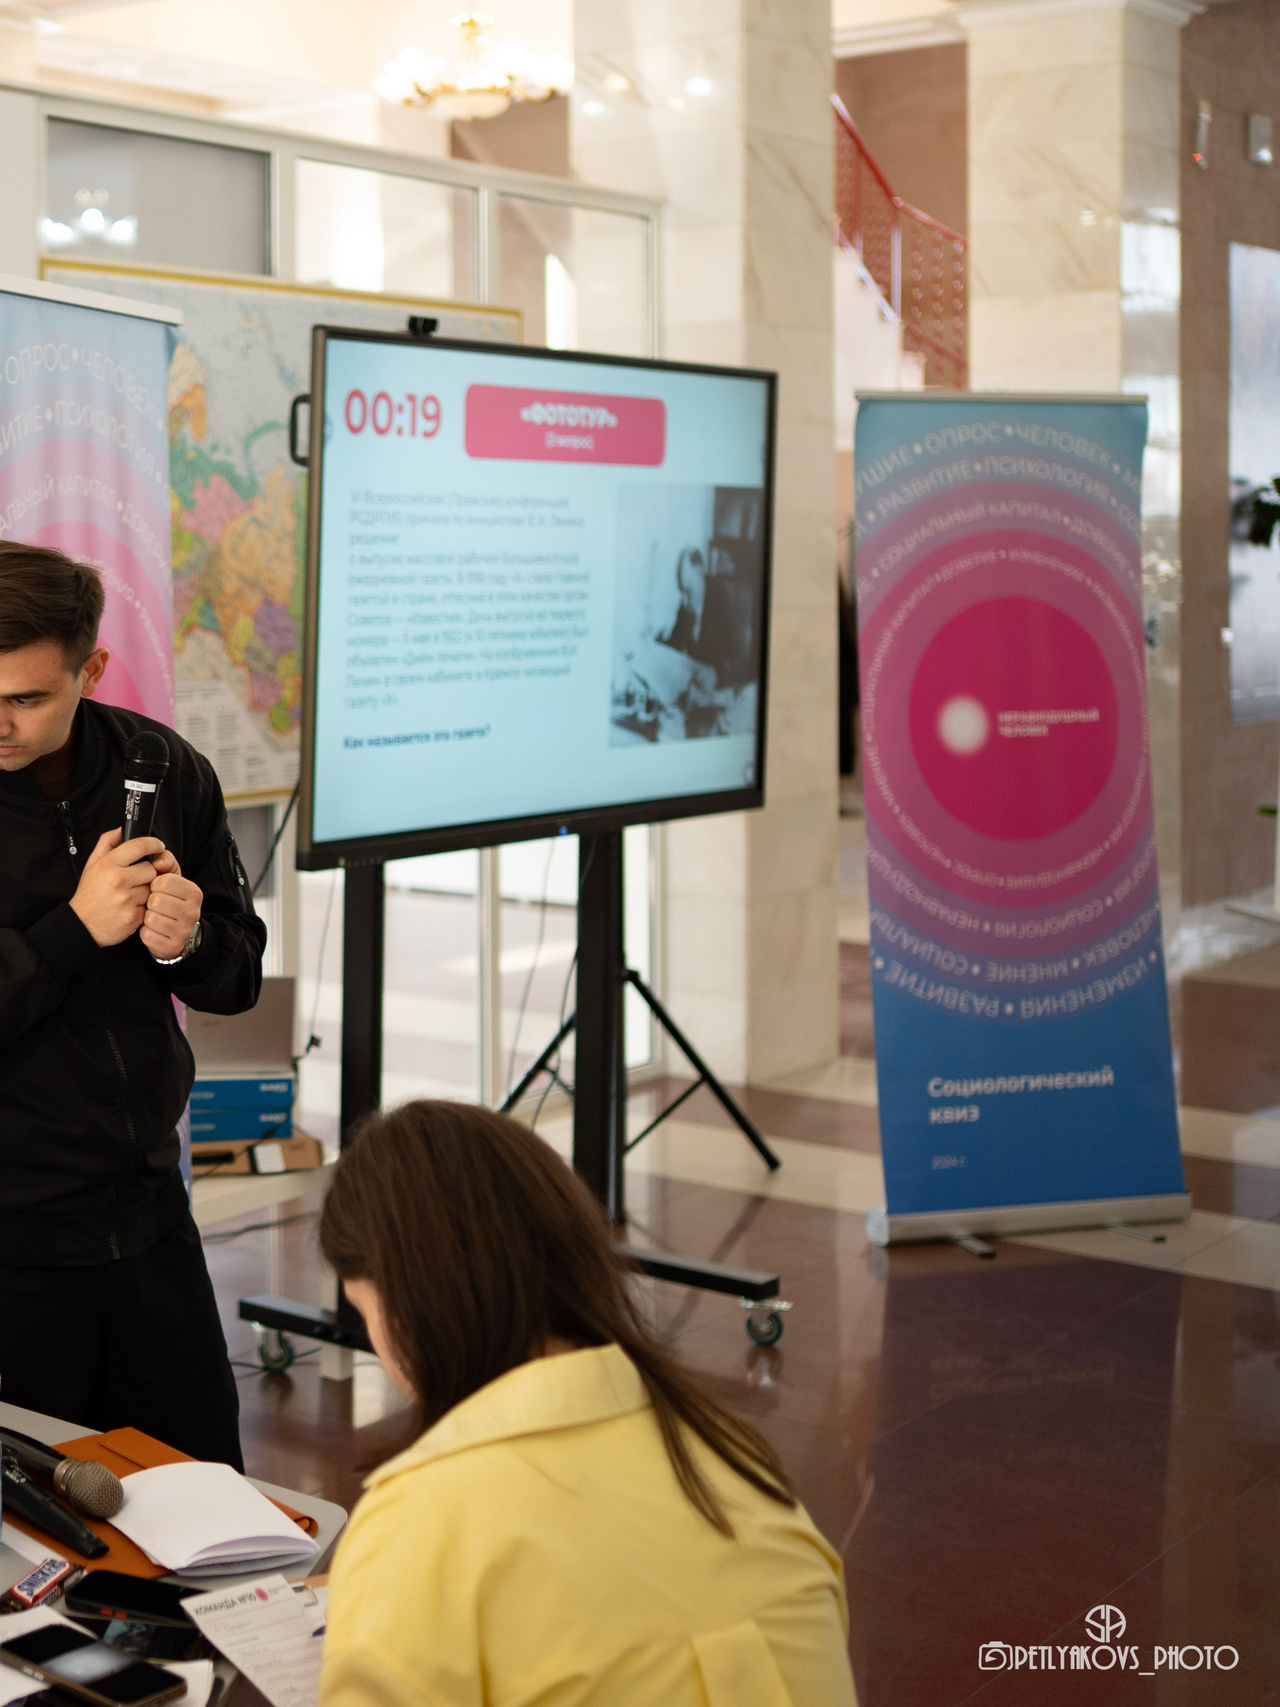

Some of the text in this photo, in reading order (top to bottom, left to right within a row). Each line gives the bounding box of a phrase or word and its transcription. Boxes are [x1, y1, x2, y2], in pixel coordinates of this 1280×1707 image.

[4, 343, 69, 385] ОПРОС
[80, 347, 156, 422] ЧЕЛОВЕК
[344, 389, 442, 439] 00:19
[924, 421, 1003, 454] ОПРОС
[1018, 424, 1111, 466] ЧЕЛОВЕК
[875, 459, 972, 516] РАЗВИТИЕ
[982, 455, 1110, 505] ПСИХОЛОГИЯ
[866, 838, 980, 932] НЕРАВНОДУШИ
[871, 908, 969, 977] СОЦИАЛЬ
[884, 957, 1150, 1019] ИЗМЕНЕНИЯ РАЗВИТИЕ
[986, 960, 1069, 985] МНЕНИЕ
[928, 1065, 1115, 1098] Социологический
[929, 1105, 980, 1125] квиз
[17, 1559, 68, 1598] SNICKERS
[193, 1597, 238, 1616] КОМАНДА
